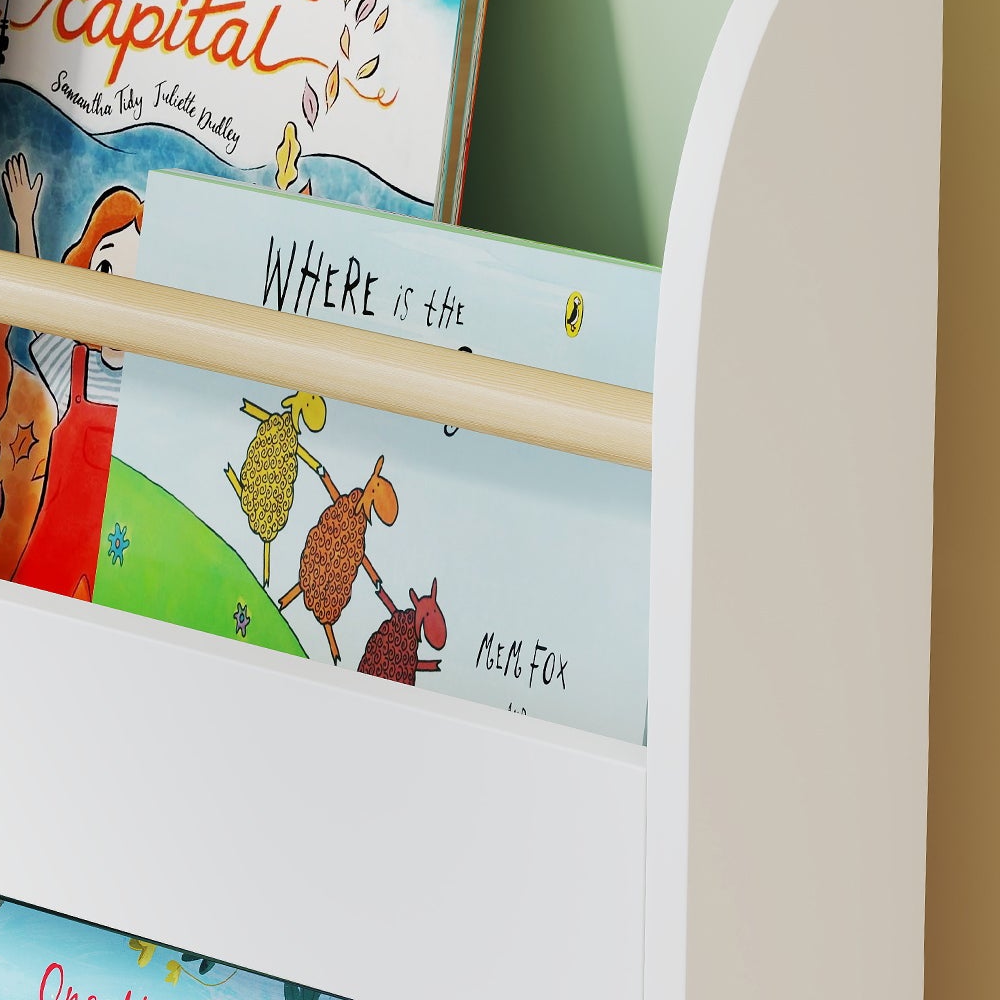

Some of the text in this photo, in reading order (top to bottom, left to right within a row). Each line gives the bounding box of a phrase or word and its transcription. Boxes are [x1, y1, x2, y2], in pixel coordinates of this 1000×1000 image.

[50, 70, 241, 155] Samantha Tidy Juliette Dudley
[263, 236, 378, 317] WHERE
[475, 632, 568, 690] MEM FOX
